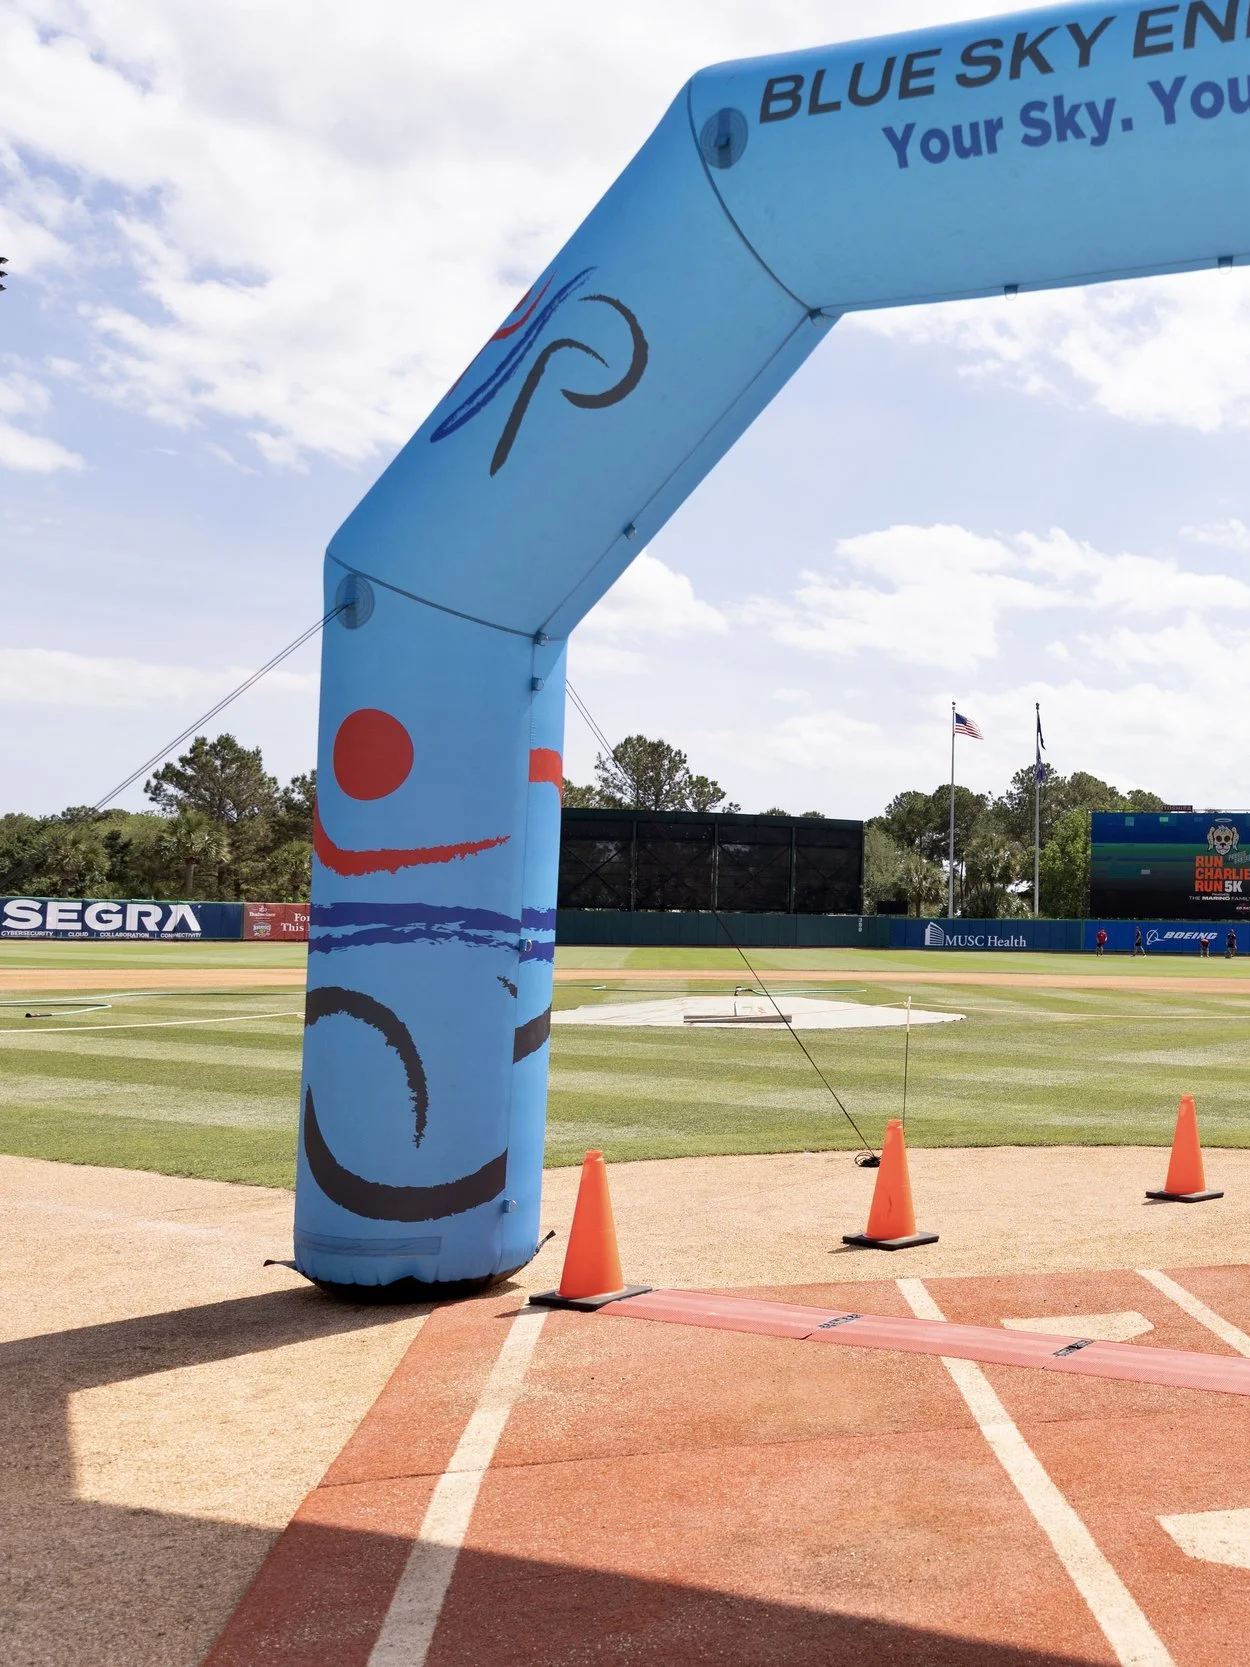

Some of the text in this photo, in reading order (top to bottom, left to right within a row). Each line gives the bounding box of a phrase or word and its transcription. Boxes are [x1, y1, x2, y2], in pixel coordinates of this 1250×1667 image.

[759, 48, 942, 124] BLUE
[955, 16, 1116, 88] SKY
[882, 116, 1004, 169] Your
[1019, 94, 1134, 147] Sky.
[1196, 856, 1223, 867] RUN
[1195, 880, 1243, 893] RUN 5K
[2, 899, 202, 932] SEGRA
[280, 922, 305, 932] This
[99, 931, 150, 939] COLLABORATION
[944, 935, 1027, 947] MUSC Health
[1163, 931, 1218, 940] BOEING
